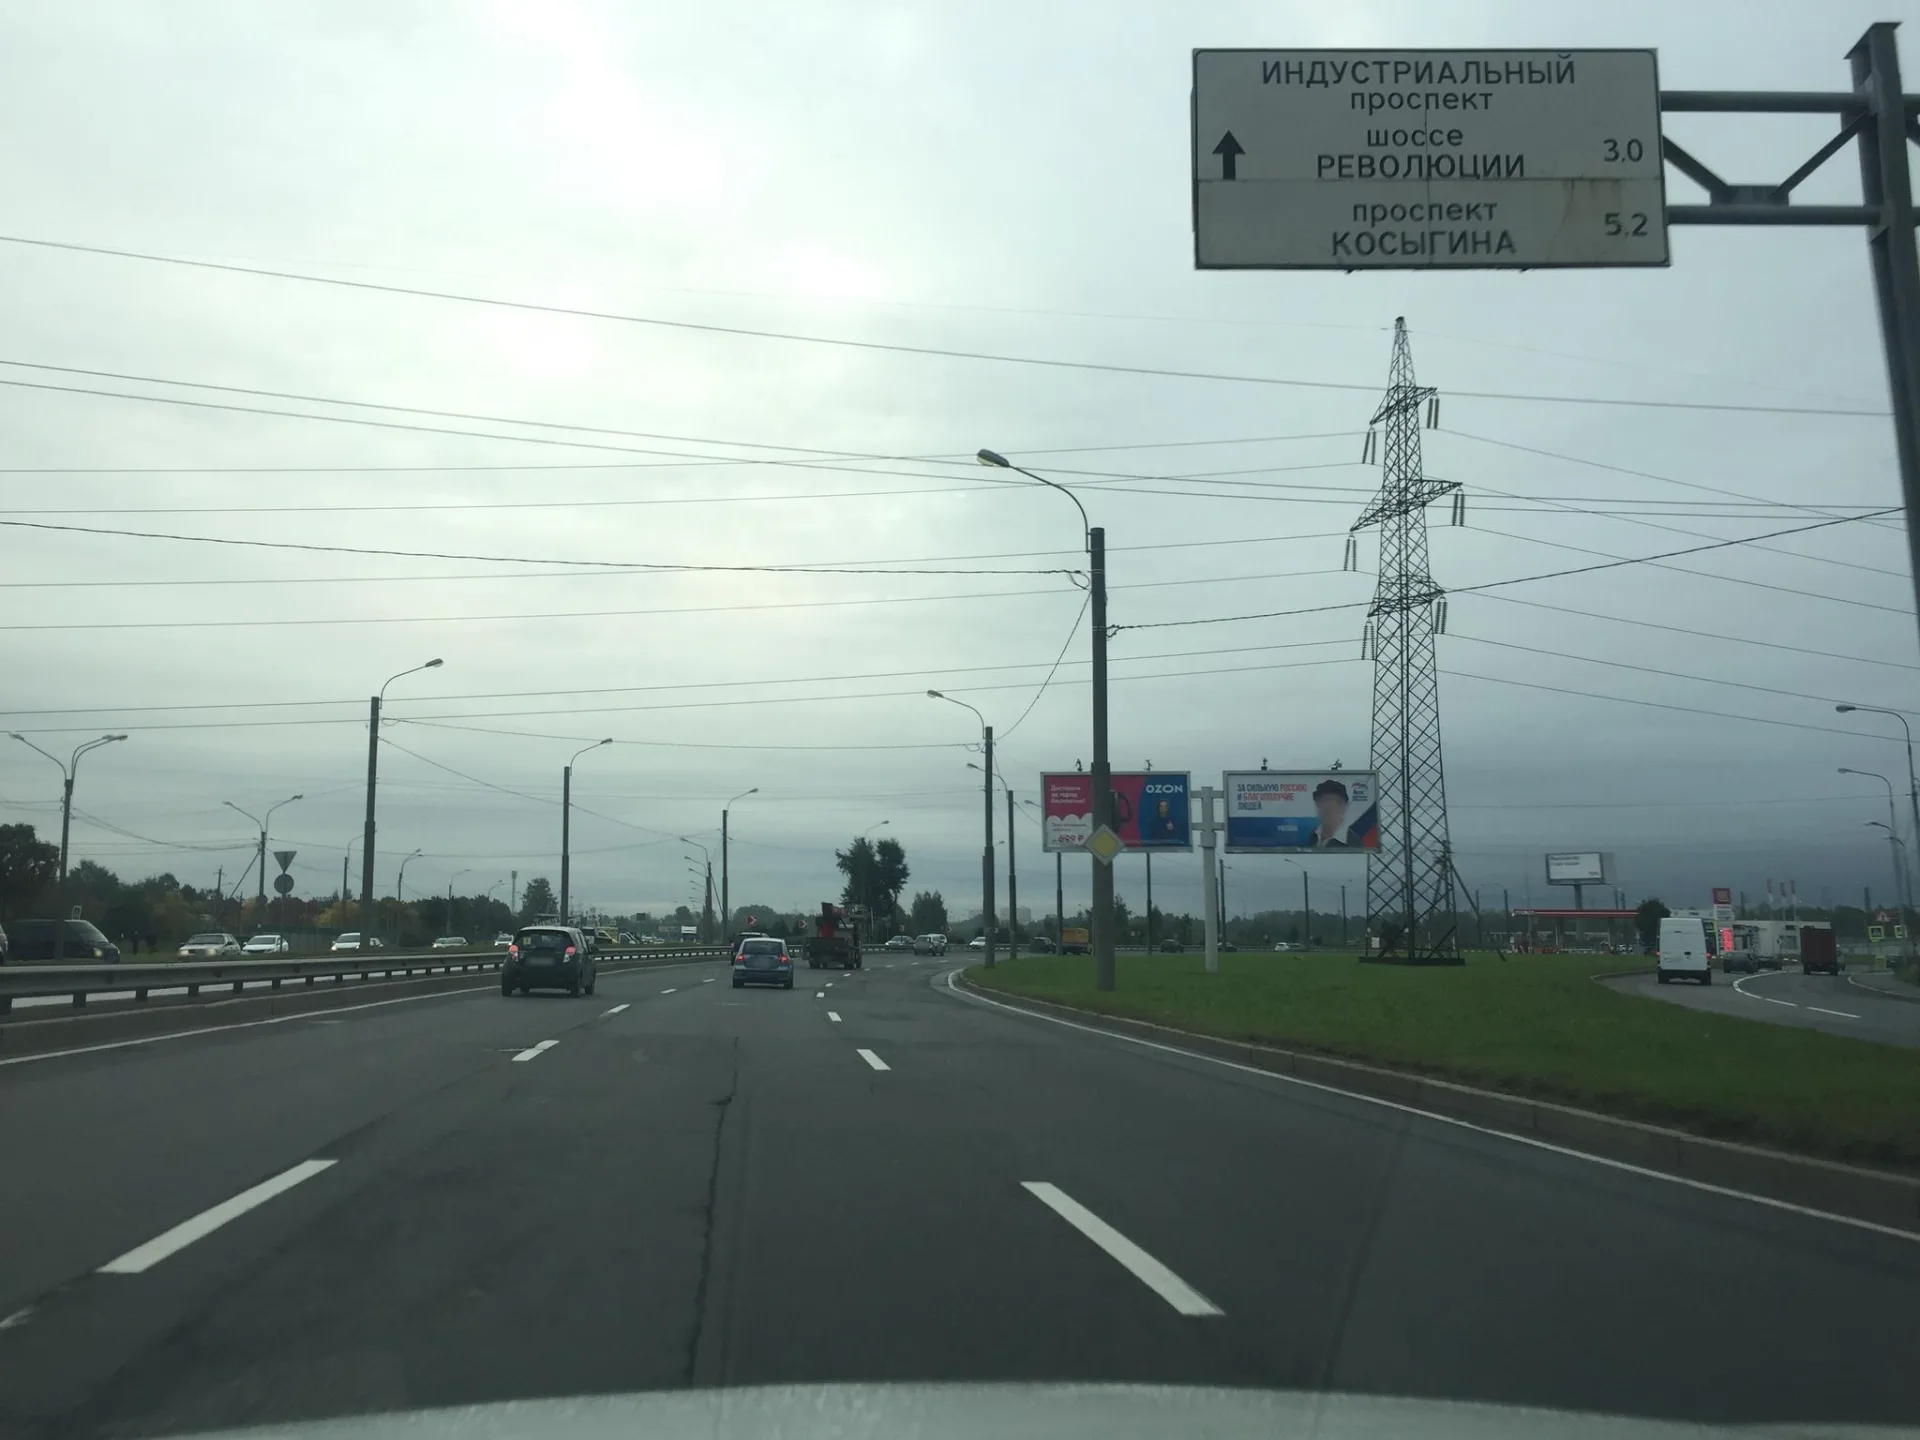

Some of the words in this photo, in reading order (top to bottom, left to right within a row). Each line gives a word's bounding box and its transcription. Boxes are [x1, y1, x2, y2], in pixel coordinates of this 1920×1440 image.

[1262, 54, 1576, 88] ИНДУСТРИАЛЬНЫЙ
[1351, 89, 1493, 115] проспект
[1366, 126, 1463, 148] шоссе
[1317, 154, 1525, 181] РЕВОЛЮЦИИ
[1352, 201, 1498, 227] проспект
[1331, 230, 1517, 257] КОСЫГИНА
[1145, 784, 1184, 794] OZON
[1237, 783, 1246, 792] ЗА
